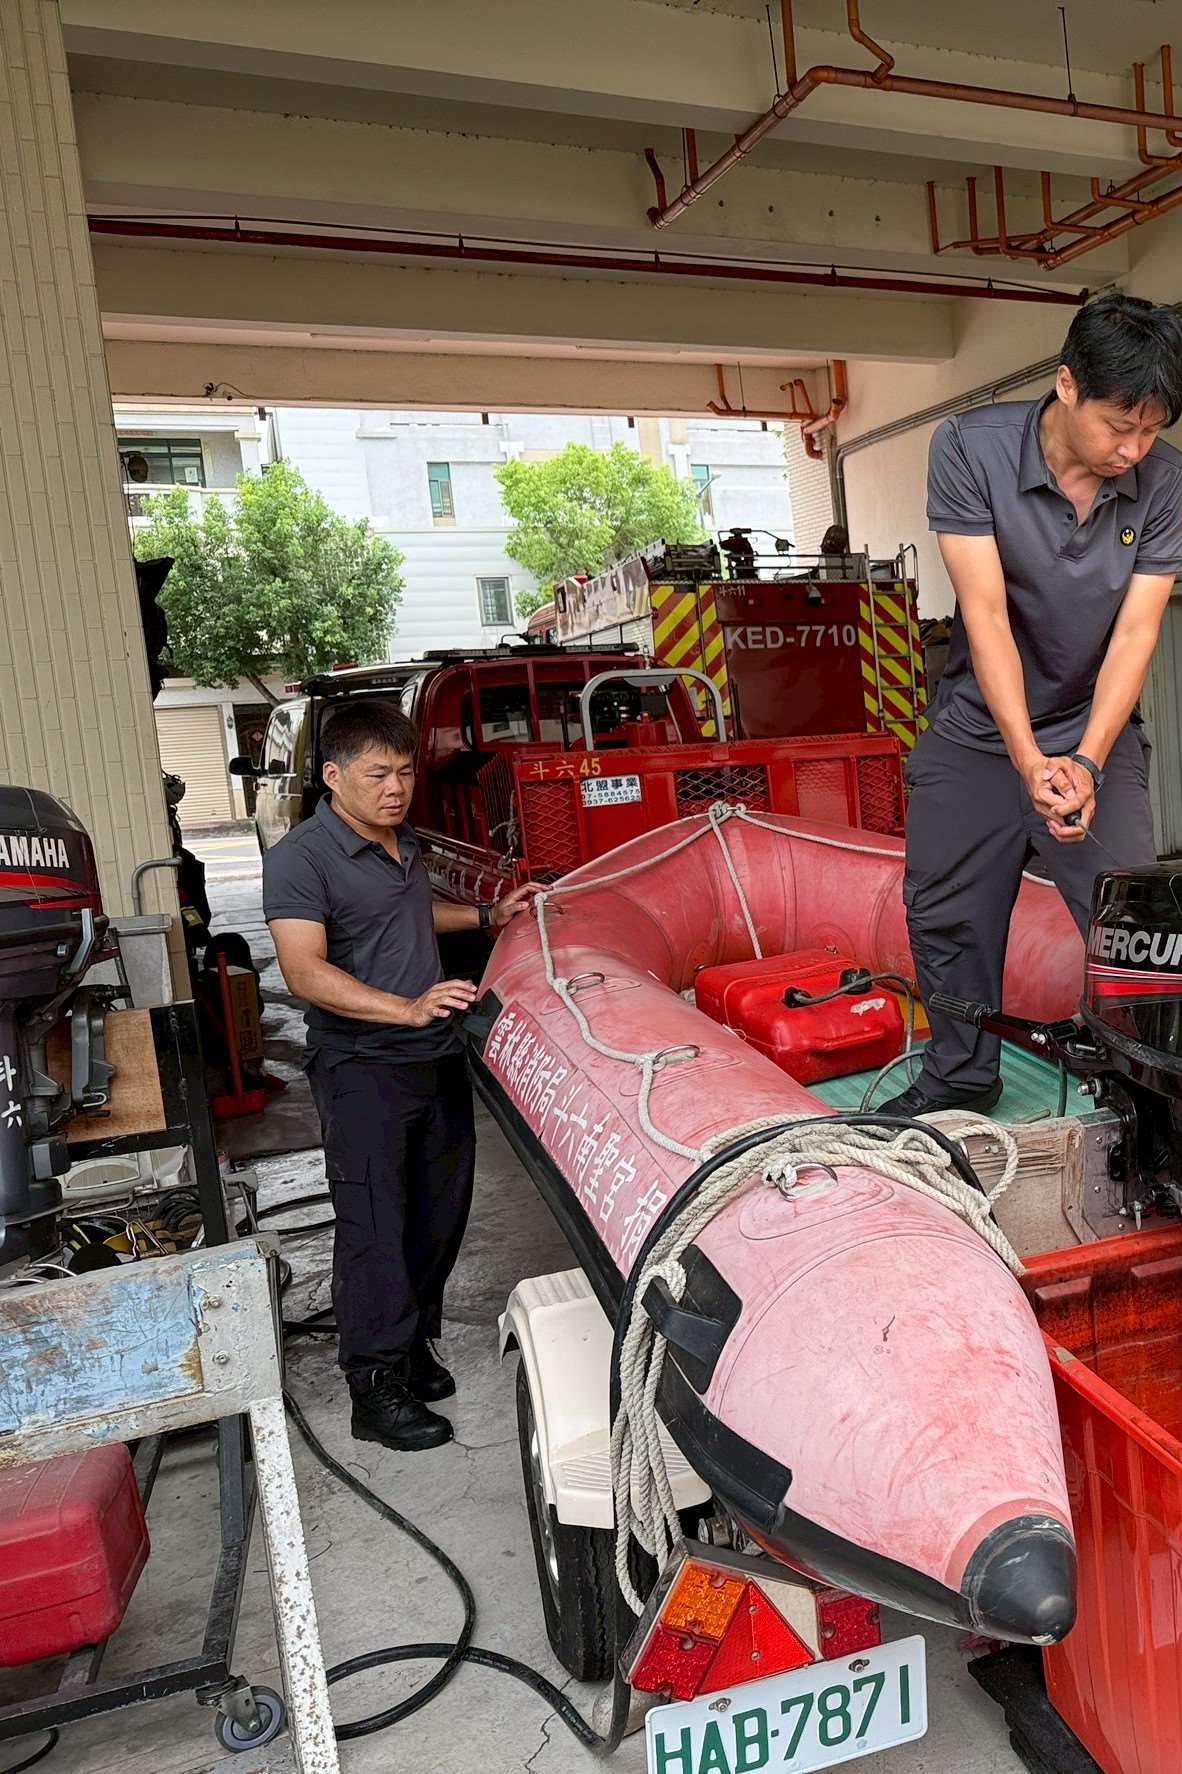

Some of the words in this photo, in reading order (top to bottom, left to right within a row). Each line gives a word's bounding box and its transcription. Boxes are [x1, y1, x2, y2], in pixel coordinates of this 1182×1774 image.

[724, 624, 857, 650] KED-7710
[529, 757, 601, 781] 斗六45
[581, 777, 638, 793] 北盟事業
[655, 1663, 911, 1774] HAB-7871
